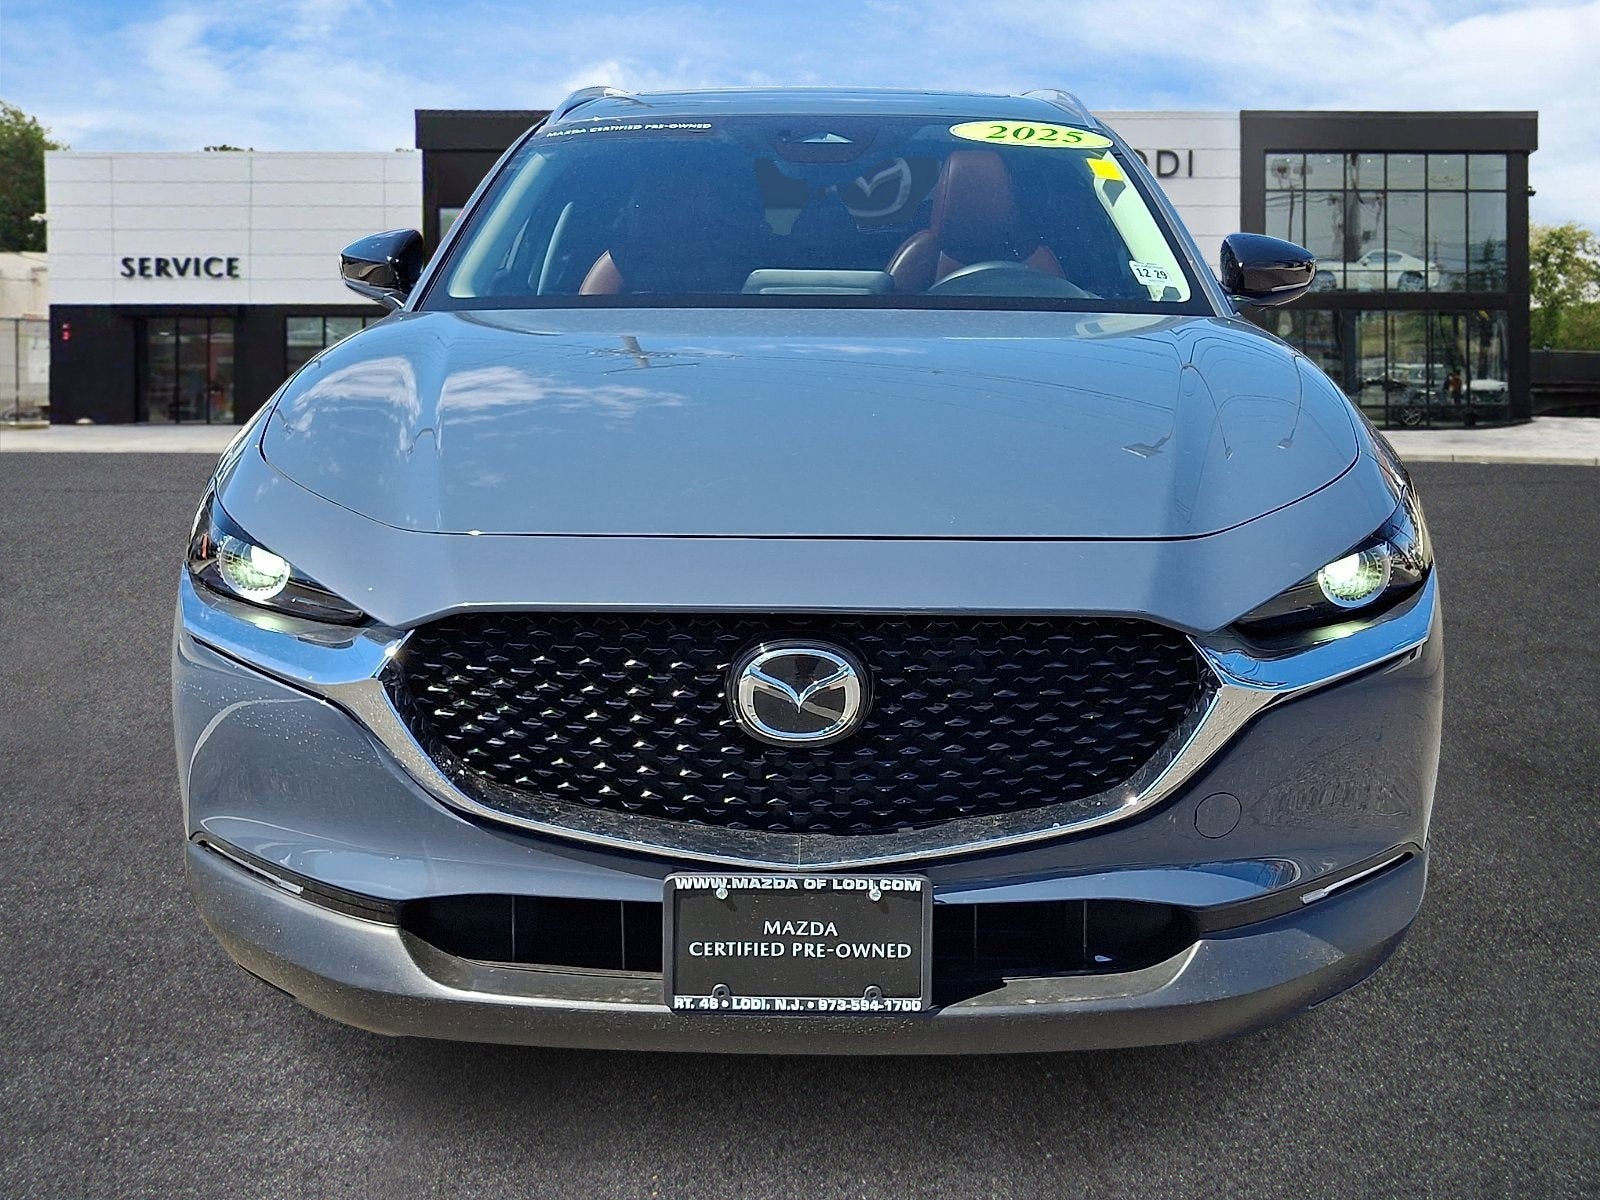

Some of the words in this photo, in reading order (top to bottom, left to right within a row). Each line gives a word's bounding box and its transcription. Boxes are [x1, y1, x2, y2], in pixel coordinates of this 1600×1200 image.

[546, 128, 586, 137] MAZDA
[590, 124, 642, 133] CERTIFIED
[986, 125, 1084, 143] 2025
[1133, 149, 1194, 178] DI
[120, 257, 240, 278] SERVICE
[1135, 268, 1151, 278] 12
[1153, 269, 1168, 280] 29
[675, 877, 798, 890] WWW.MAZDA
[803, 878, 827, 890] OF
[763, 921, 839, 937] MAZDA
[688, 942, 785, 957] CERTIFIED
[791, 943, 912, 959] PRE-OWNED
[674, 997, 695, 1010] RT.
[732, 998, 770, 1010] LODI,
[774, 998, 804, 1011] N.J.
[818, 1000, 922, 1012] 973-594-1700
